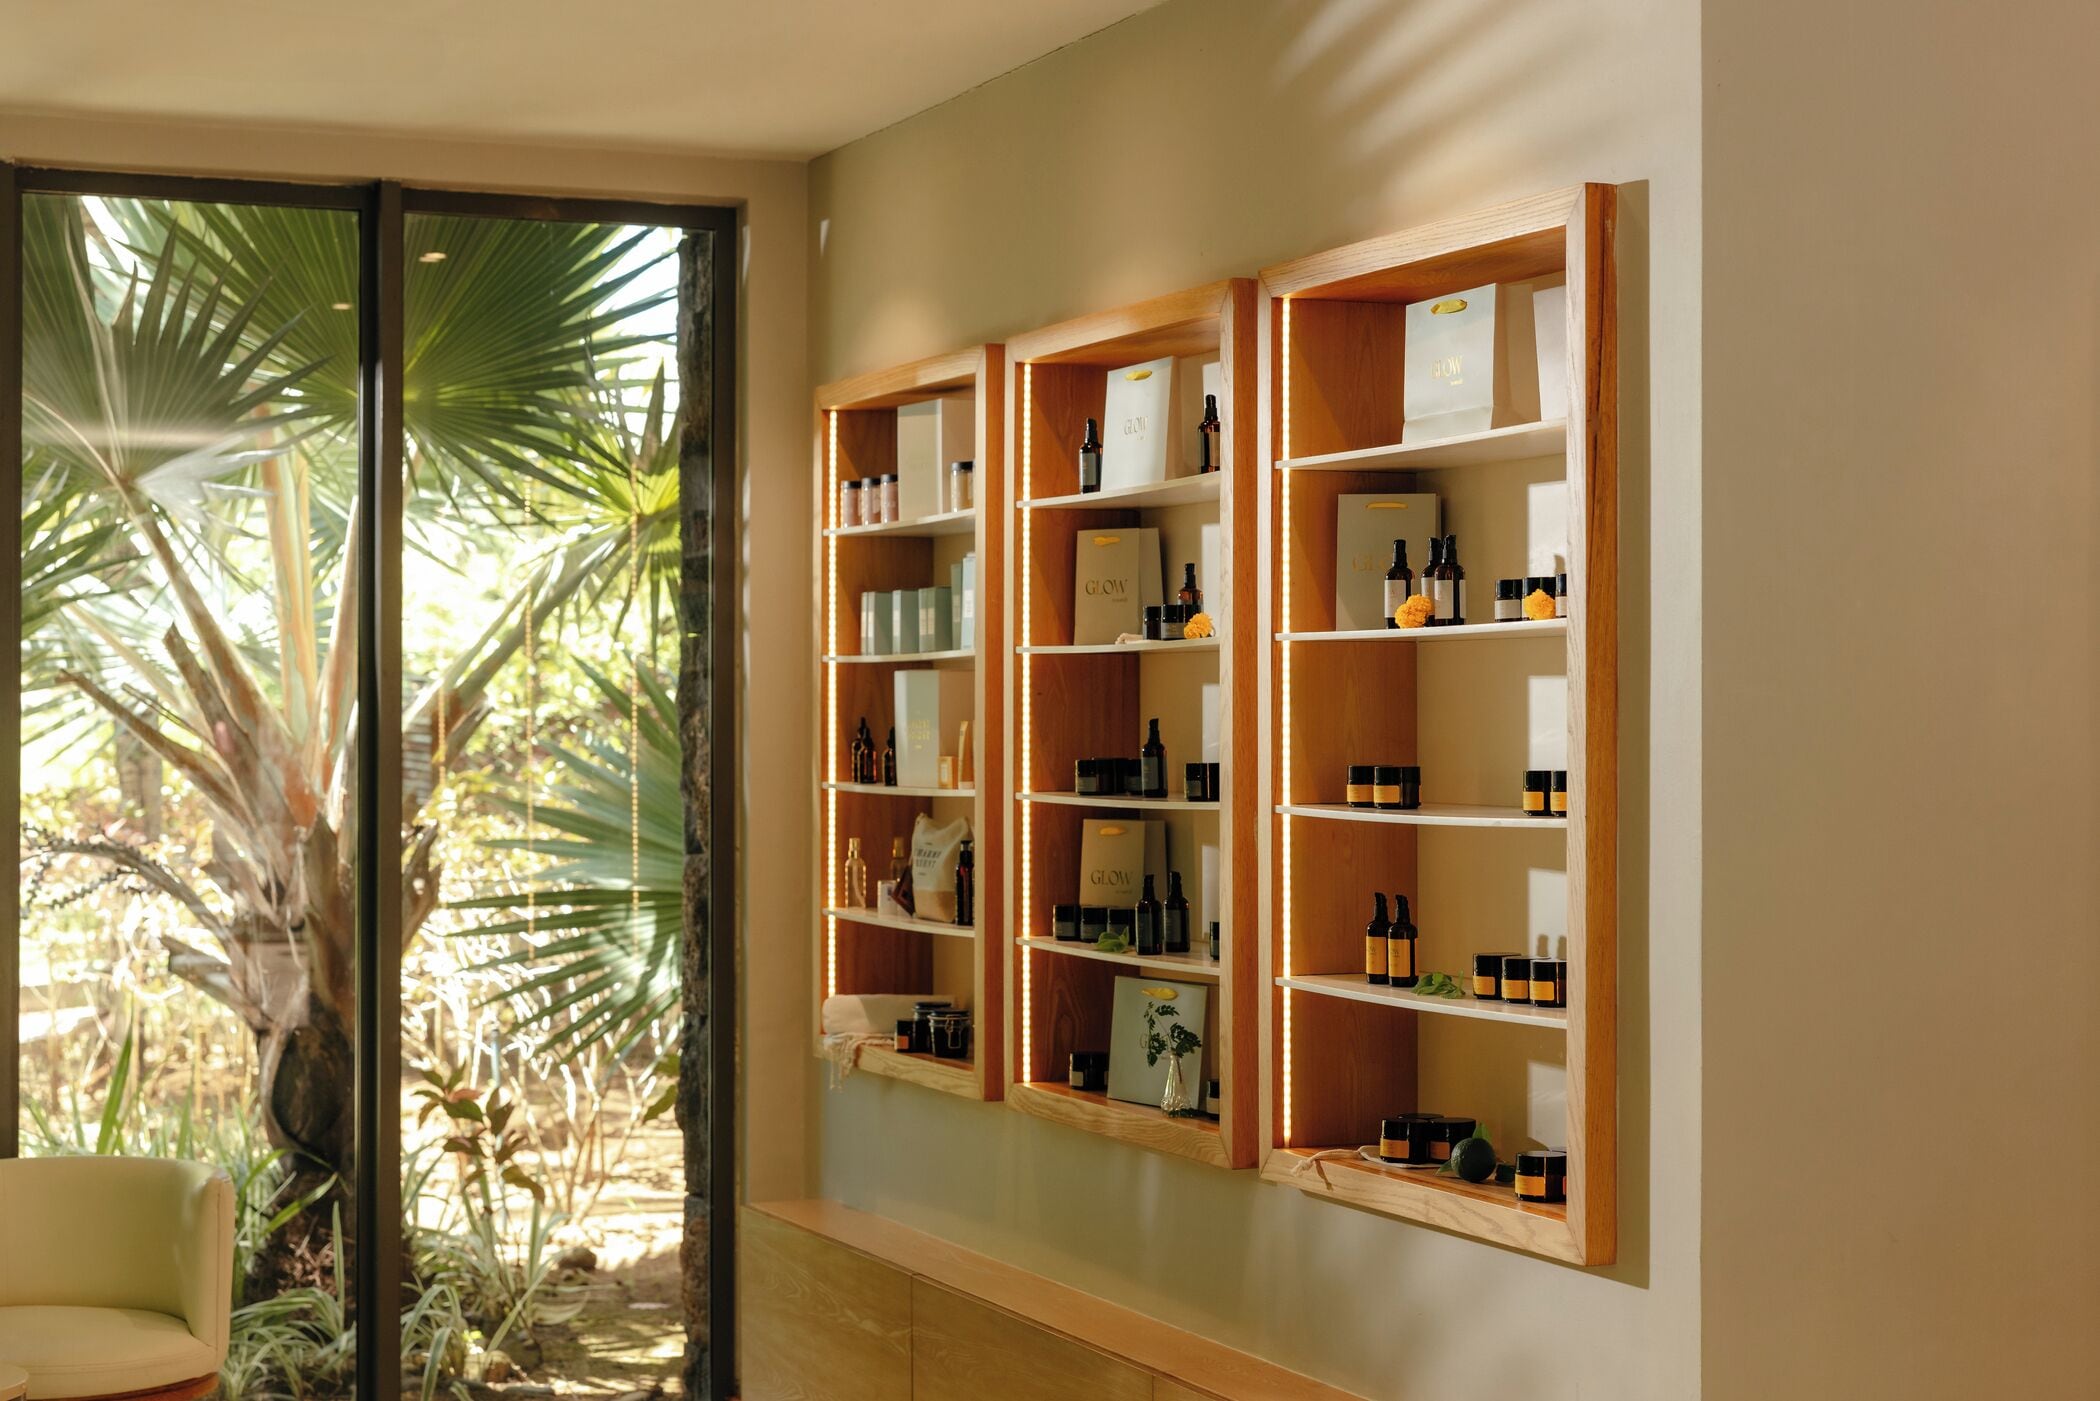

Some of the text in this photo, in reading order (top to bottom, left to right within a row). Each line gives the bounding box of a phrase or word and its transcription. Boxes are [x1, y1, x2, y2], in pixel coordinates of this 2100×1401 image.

[1431, 354, 1463, 379] GLOW
[1123, 415, 1148, 435] GLOW
[1085, 578, 1128, 596] GLOW
[1090, 869, 1133, 886] GLOW
